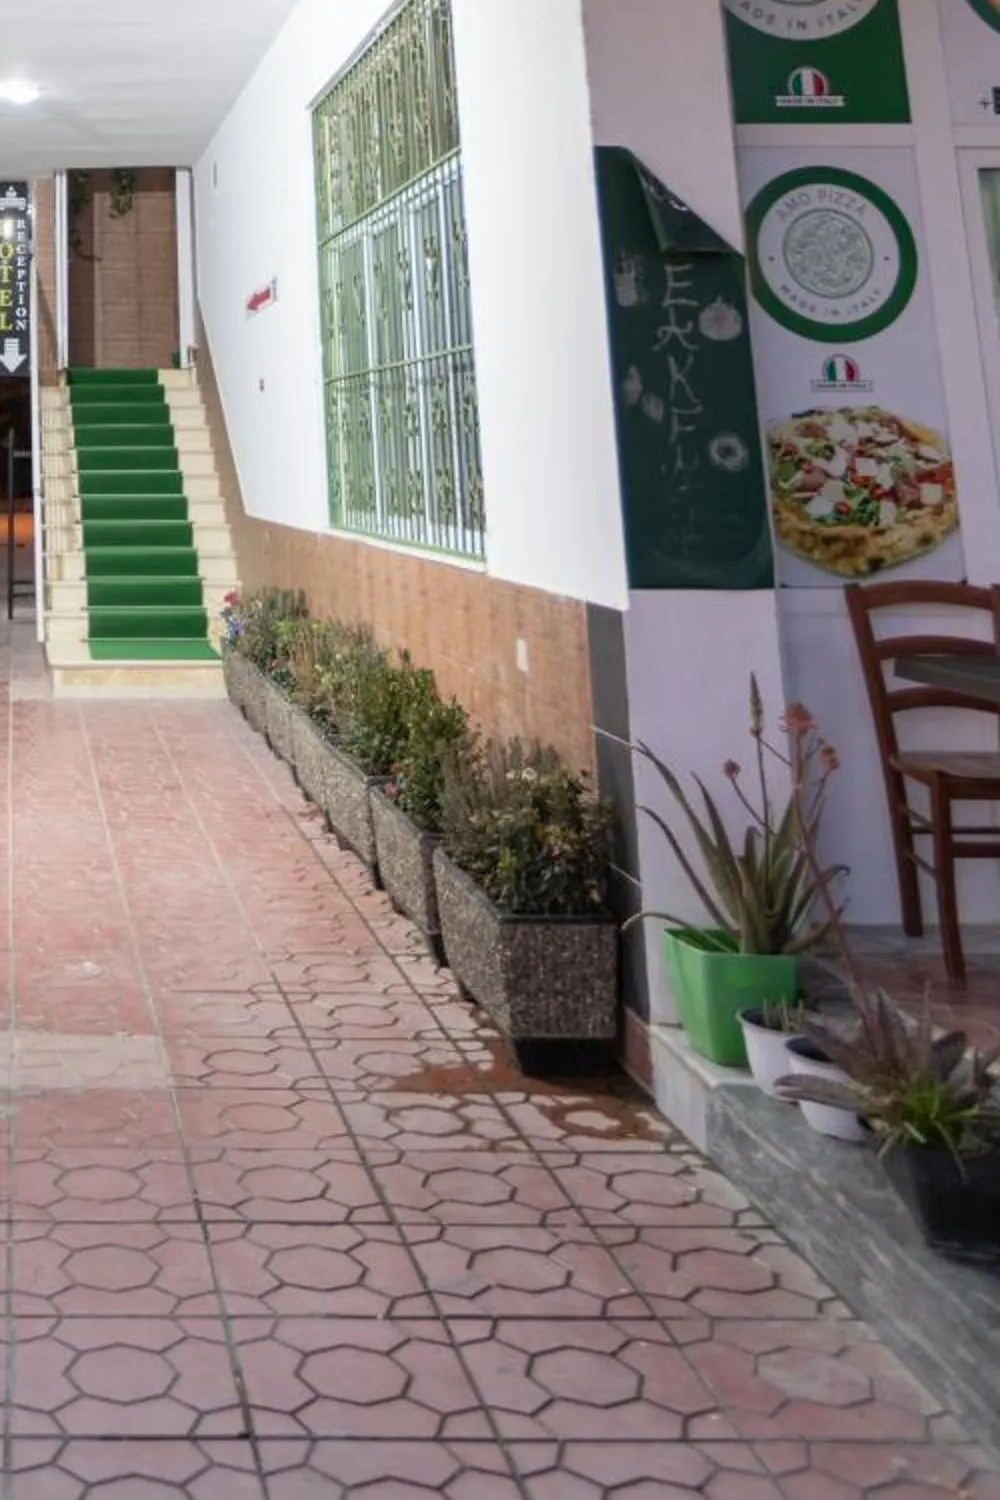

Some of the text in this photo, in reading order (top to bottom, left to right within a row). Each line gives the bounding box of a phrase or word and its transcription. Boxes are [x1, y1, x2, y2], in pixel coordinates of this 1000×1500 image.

[787, 19, 808, 30] IN
[775, 189, 866, 221] AMO PIZZA
[15, 218, 27, 332] RECEPTION
